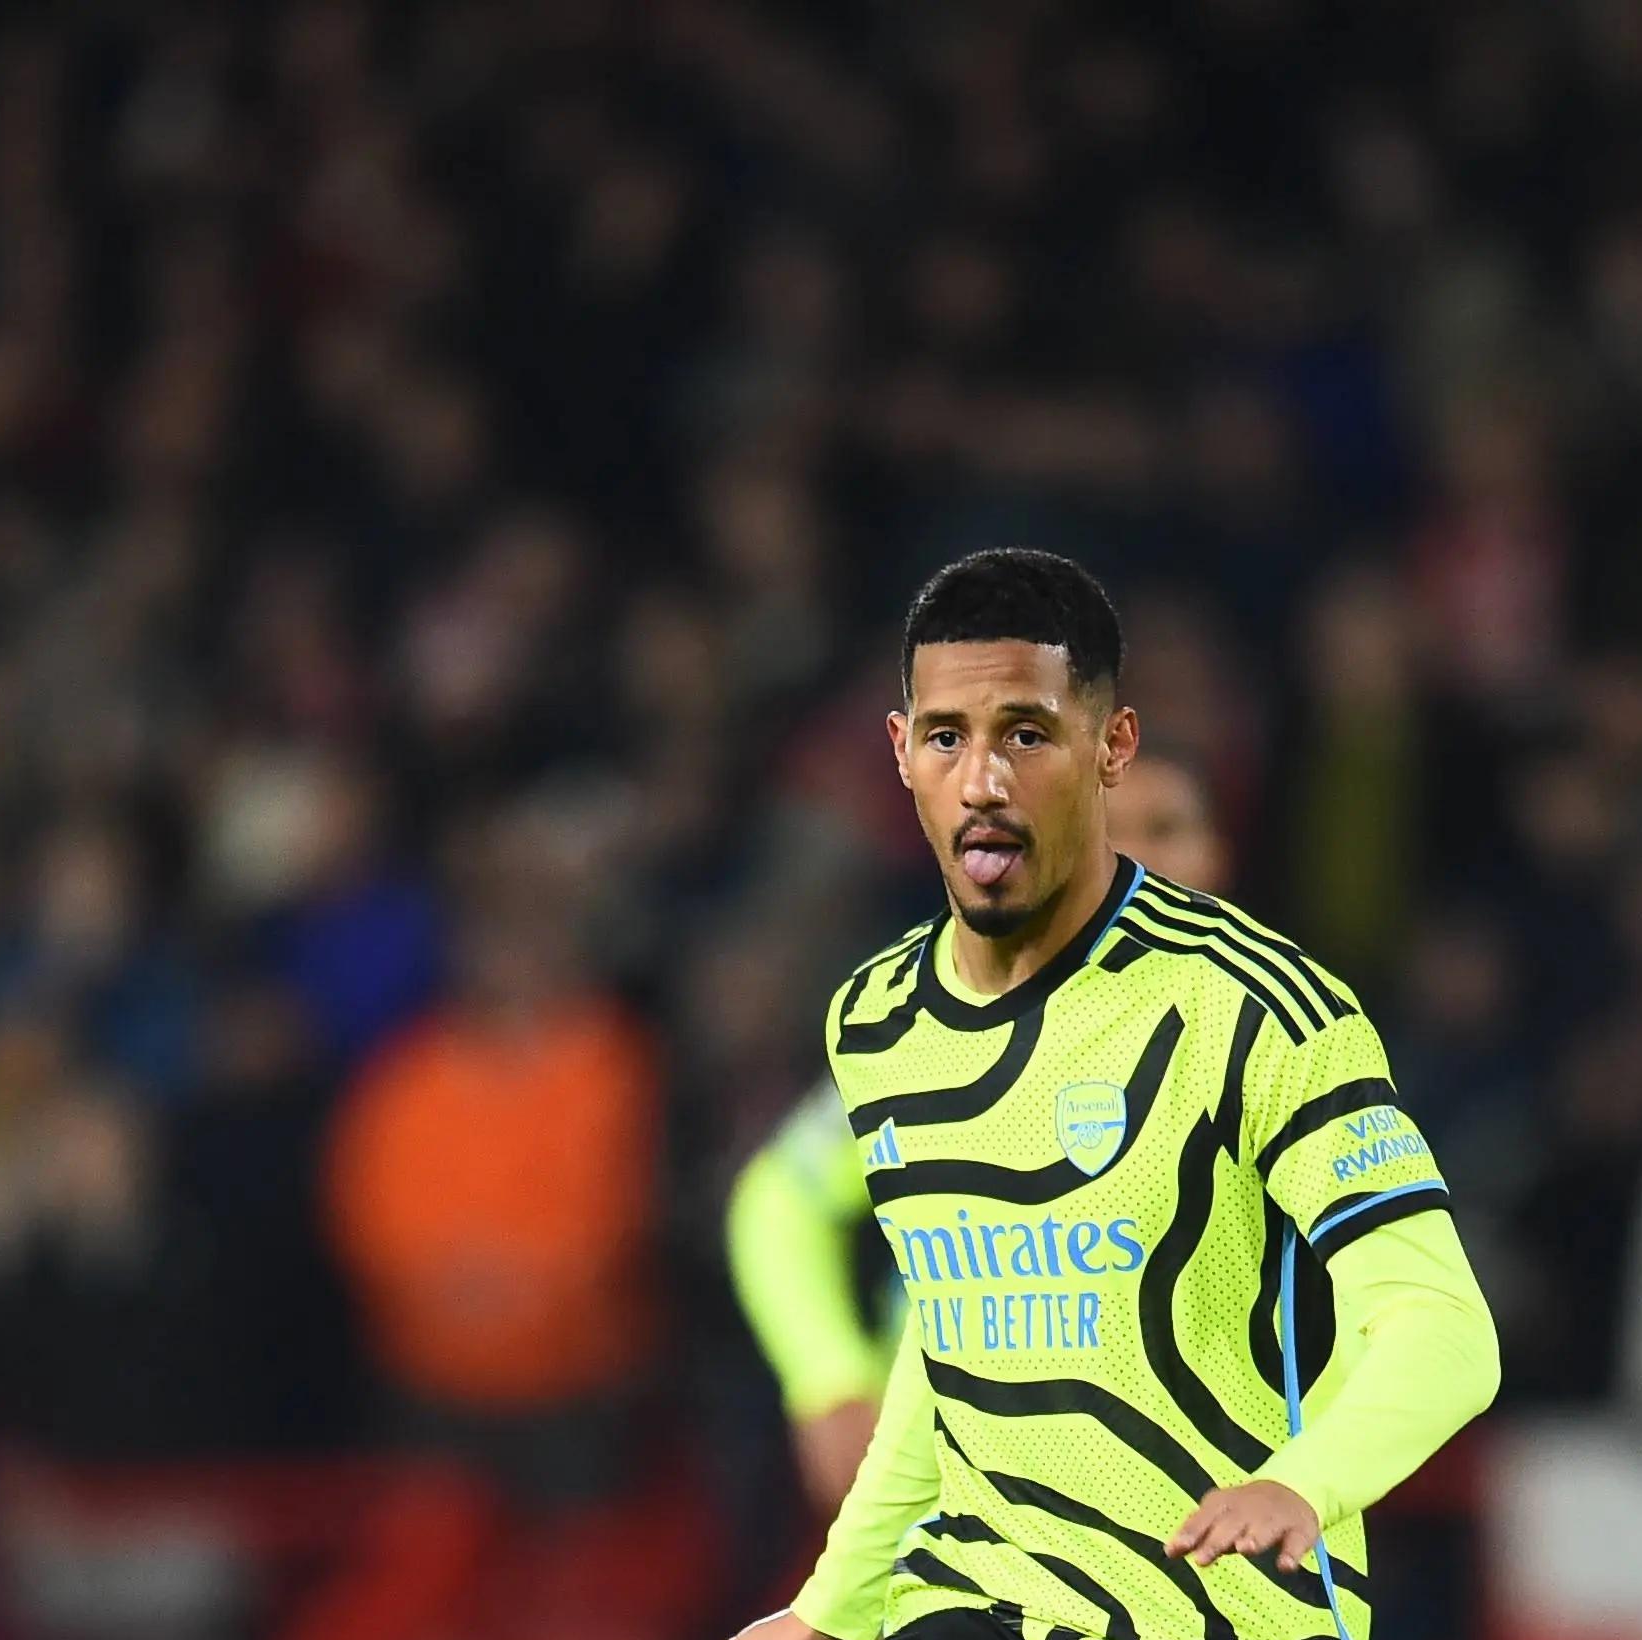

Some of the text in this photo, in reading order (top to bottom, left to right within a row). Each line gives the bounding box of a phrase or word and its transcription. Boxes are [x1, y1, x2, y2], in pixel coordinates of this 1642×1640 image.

[1067, 1098, 1115, 1112] Arsenal
[1344, 1107, 1401, 1139] VISIT
[982, 1292, 1100, 1350] BETTER
